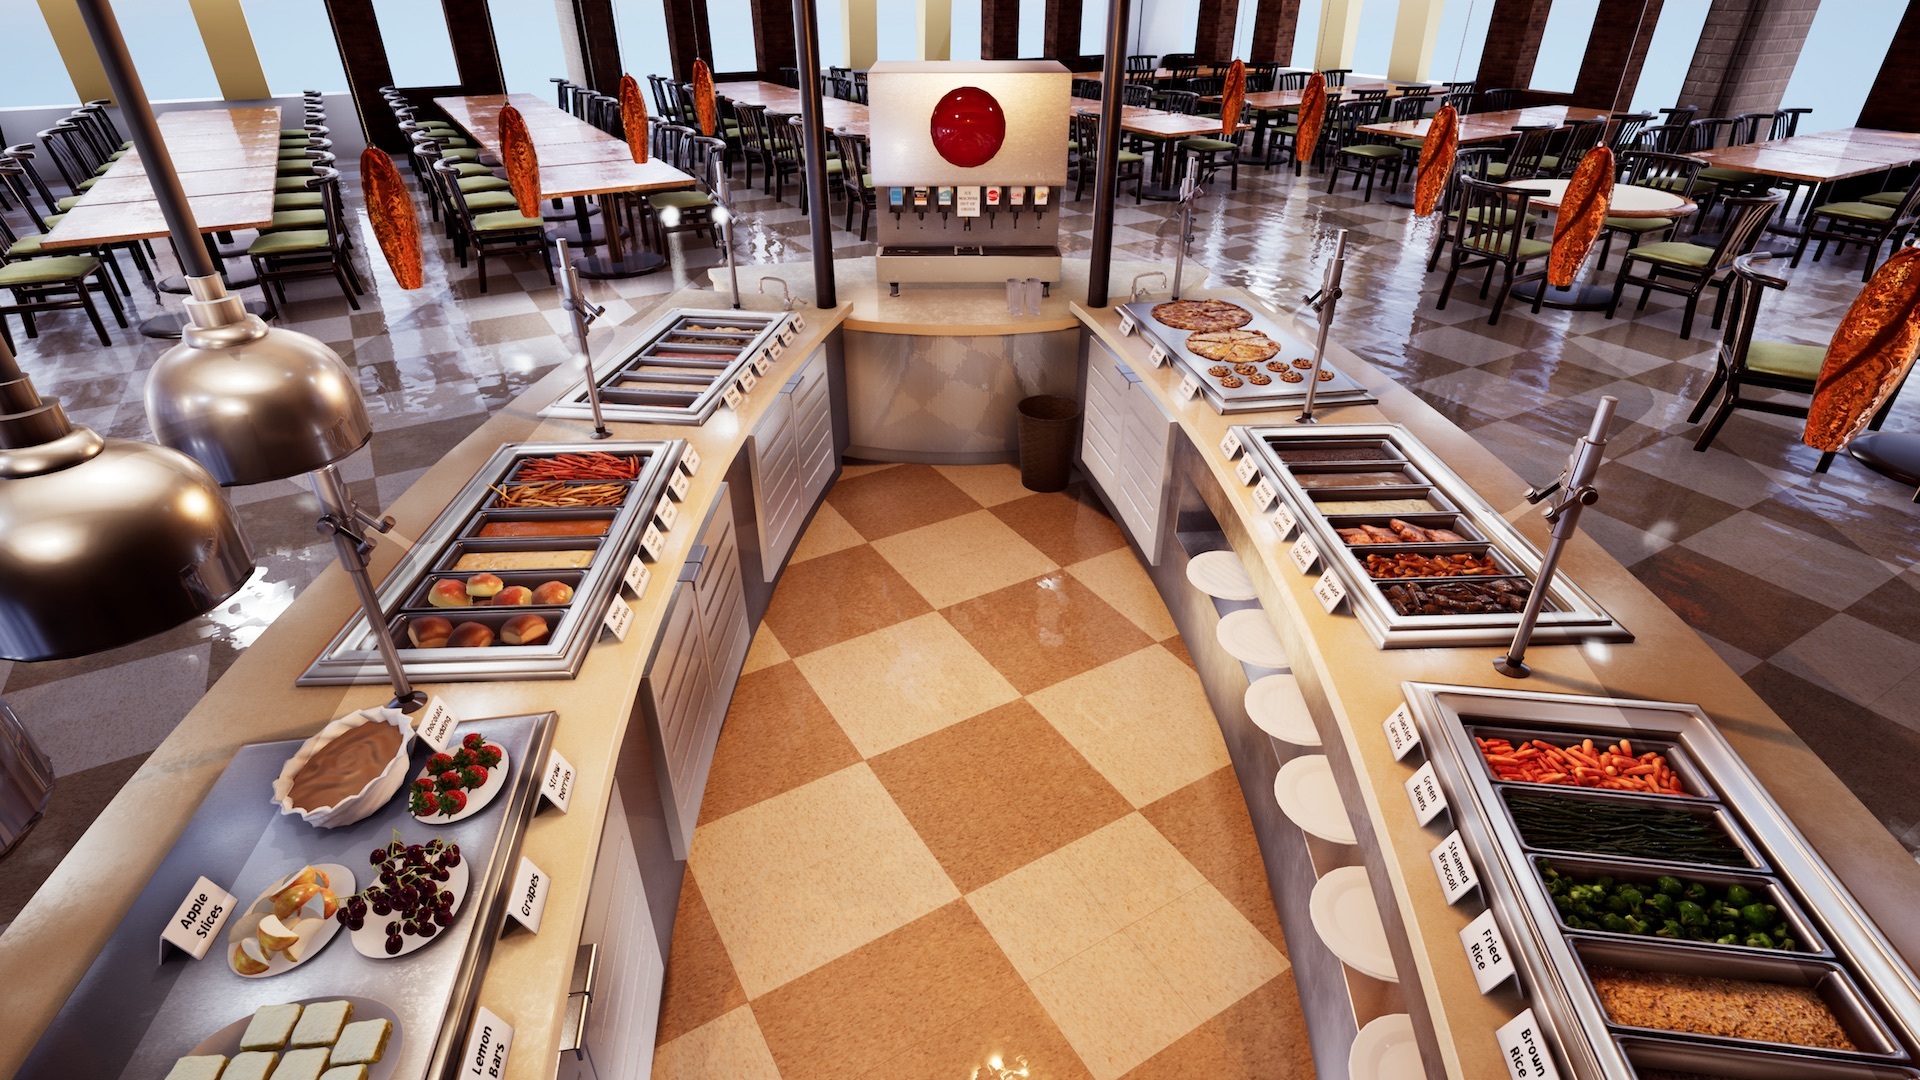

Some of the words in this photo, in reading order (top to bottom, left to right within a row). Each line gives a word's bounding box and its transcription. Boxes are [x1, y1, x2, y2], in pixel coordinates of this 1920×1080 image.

[1293, 548, 1306, 568] Chicken
[1300, 541, 1312, 558] Cajun
[1319, 589, 1331, 603] Beef
[1323, 575, 1340, 598] Braised
[615, 617, 624, 634] Dinner
[424, 705, 444, 737] Chocolate
[435, 715, 452, 743] Pudding
[1389, 721, 1402, 750] Carrots
[1397, 711, 1412, 741] Roasted
[549, 762, 560, 790] Straw-
[558, 769, 572, 801] berries
[1423, 775, 1438, 803] Green
[1413, 784, 1427, 812] Beans
[1438, 852, 1459, 892] Broccoli
[1447, 841, 1470, 884] Steamed
[521, 873, 540, 917] Grapes
[180, 893, 208, 930] Apple
[196, 904, 223, 938] Slices
[1470, 942, 1486, 971] Rice
[1482, 928, 1502, 965] Fried
[472, 1025, 492, 1076] Lemon
[488, 1042, 505, 1079] Bars
[1510, 1046, 1527, 1079] Rice
[1520, 1028, 1545, 1078] Brown
